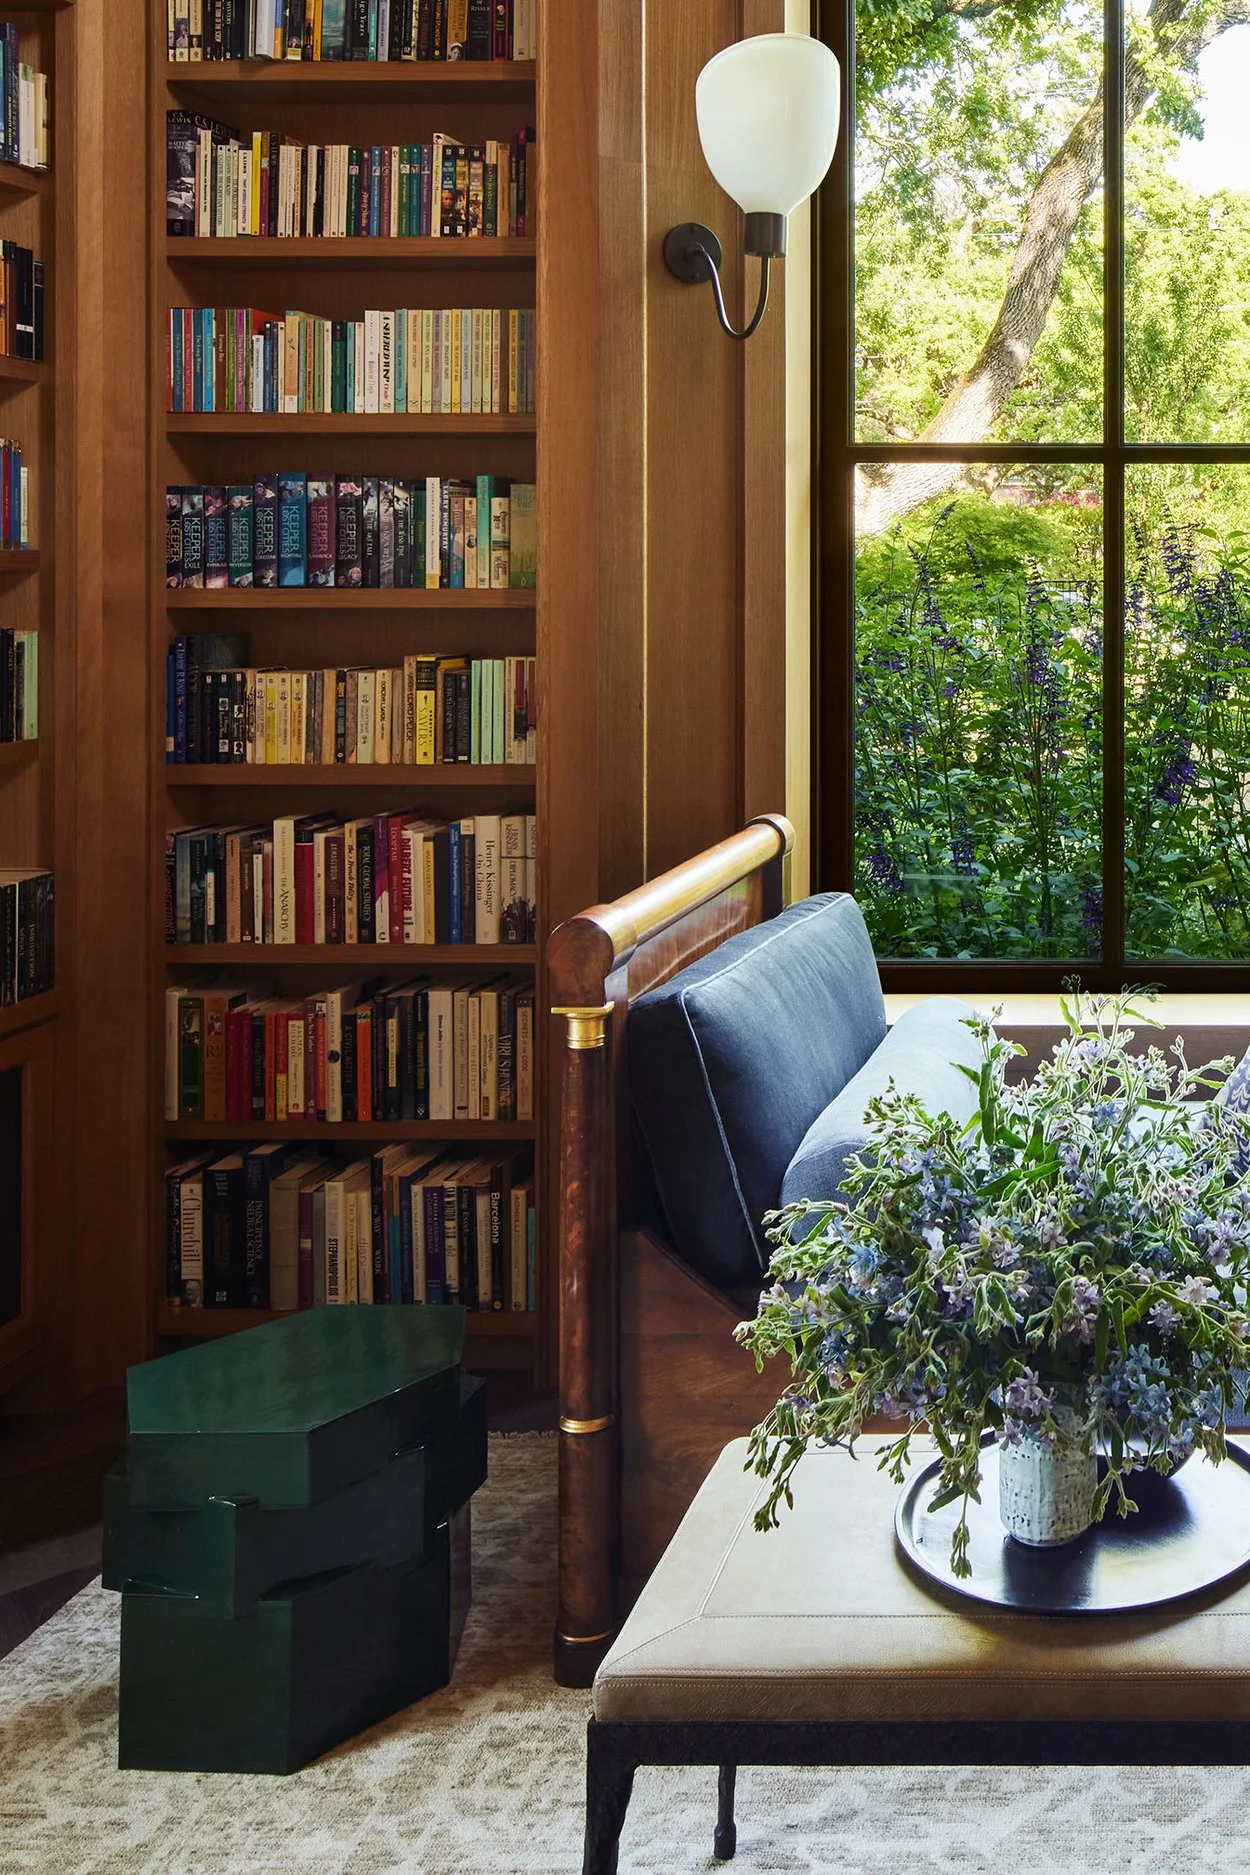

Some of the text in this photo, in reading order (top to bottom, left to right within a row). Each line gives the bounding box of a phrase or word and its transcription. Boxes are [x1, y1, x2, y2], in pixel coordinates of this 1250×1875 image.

[360, 13, 369, 36] Years
[191, 517, 201, 560] KEEPER
[208, 517, 216, 563] LOST CITIES
[217, 517, 226, 561] KEEPER
[231, 517, 239, 563] LOST CITIES
[240, 517, 249, 561] KEEPER
[264, 507, 273, 552] KEEPER
[290, 505, 299, 551] KEEPER
[318, 506, 327, 552] KEEPER
[347, 507, 357, 553] KEEPER
[418, 707, 428, 746] SAYERS
[403, 837, 412, 910] DILBERT FUTURE
[476, 854, 485, 900] On China
[485, 840, 495, 915] Henry Kissinger
[280, 877, 289, 931] THE ANARCHY
[182, 1197, 200, 1262] Churchill
[246, 1200, 255, 1277] NEURAL SCIENCE
[255, 1200, 263, 1261] PRINCIPLES OF
[491, 1192, 501, 1244] Barcelona
[328, 1238, 338, 1296] STEPHANOPOULOS
[358, 1237, 369, 1267] diary
